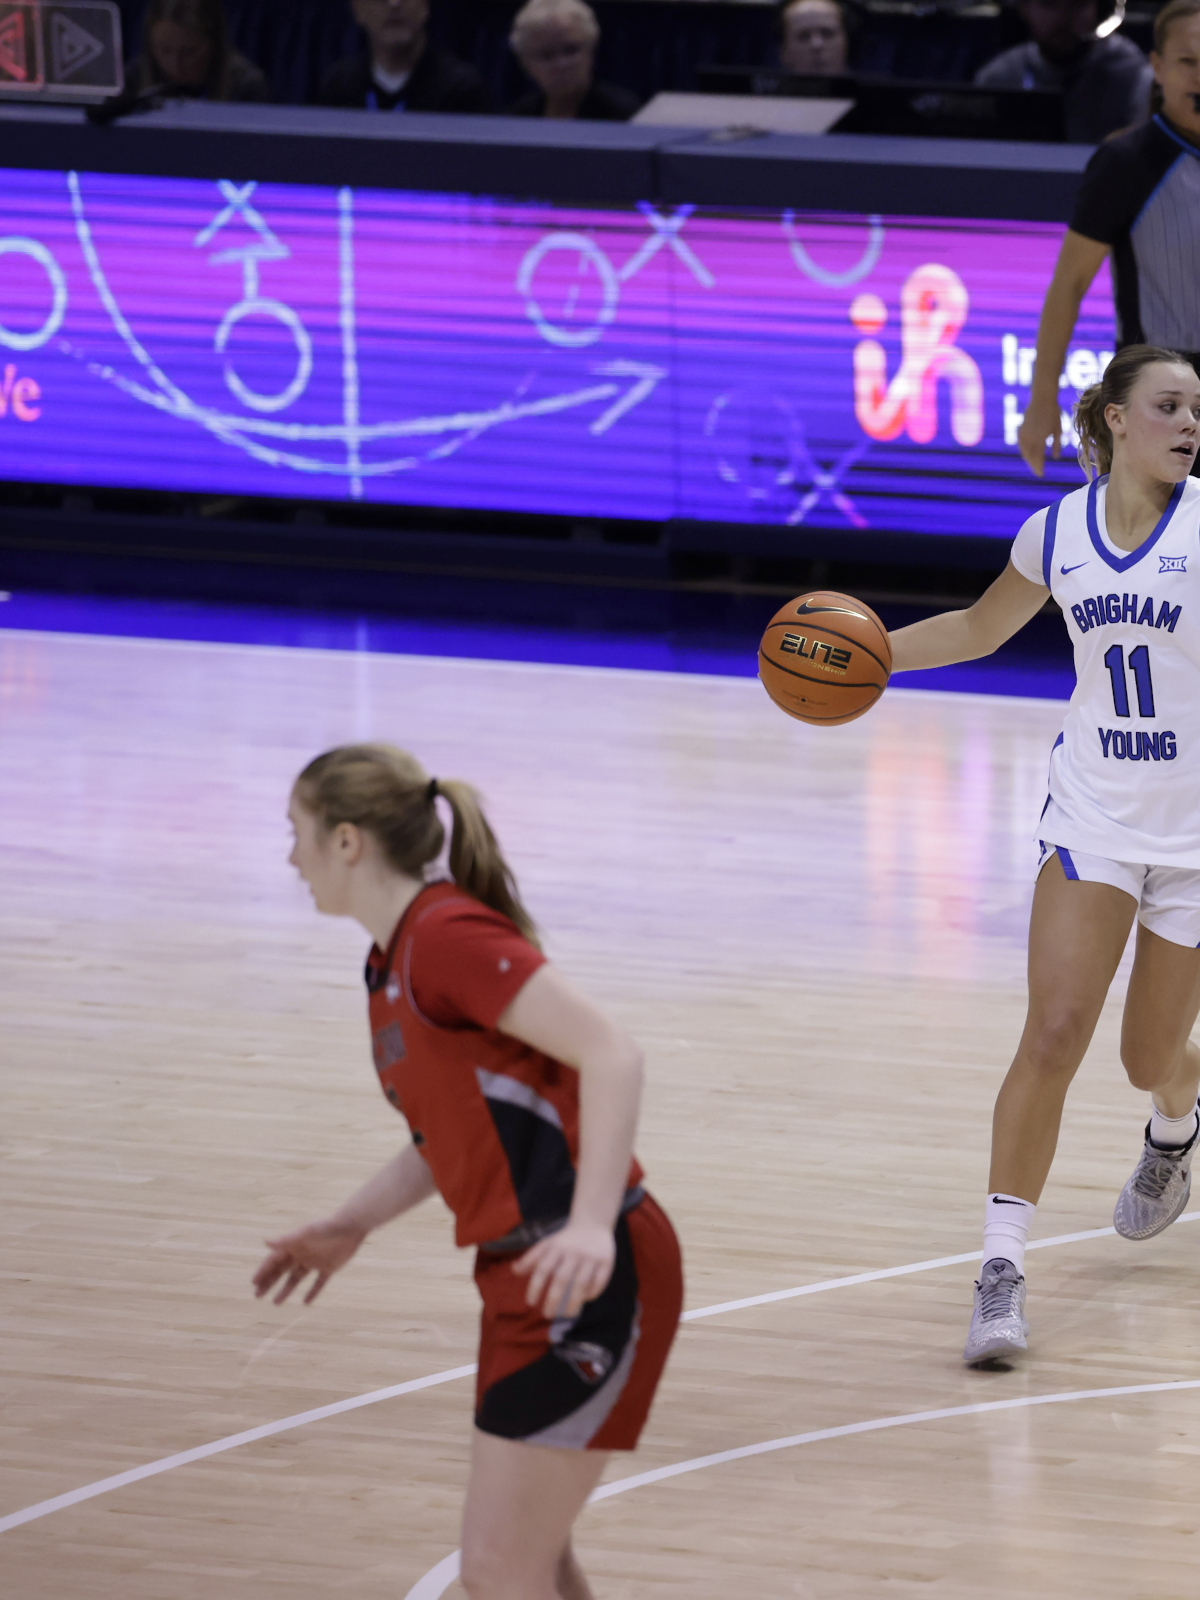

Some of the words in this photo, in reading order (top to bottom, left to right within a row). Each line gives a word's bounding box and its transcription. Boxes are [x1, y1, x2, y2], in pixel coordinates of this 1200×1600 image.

[1070, 593, 1183, 633] BRIGHAM
[780, 632, 852, 670] ELITE
[1104, 644, 1155, 718] 11
[1098, 727, 1177, 761] YOUNG
